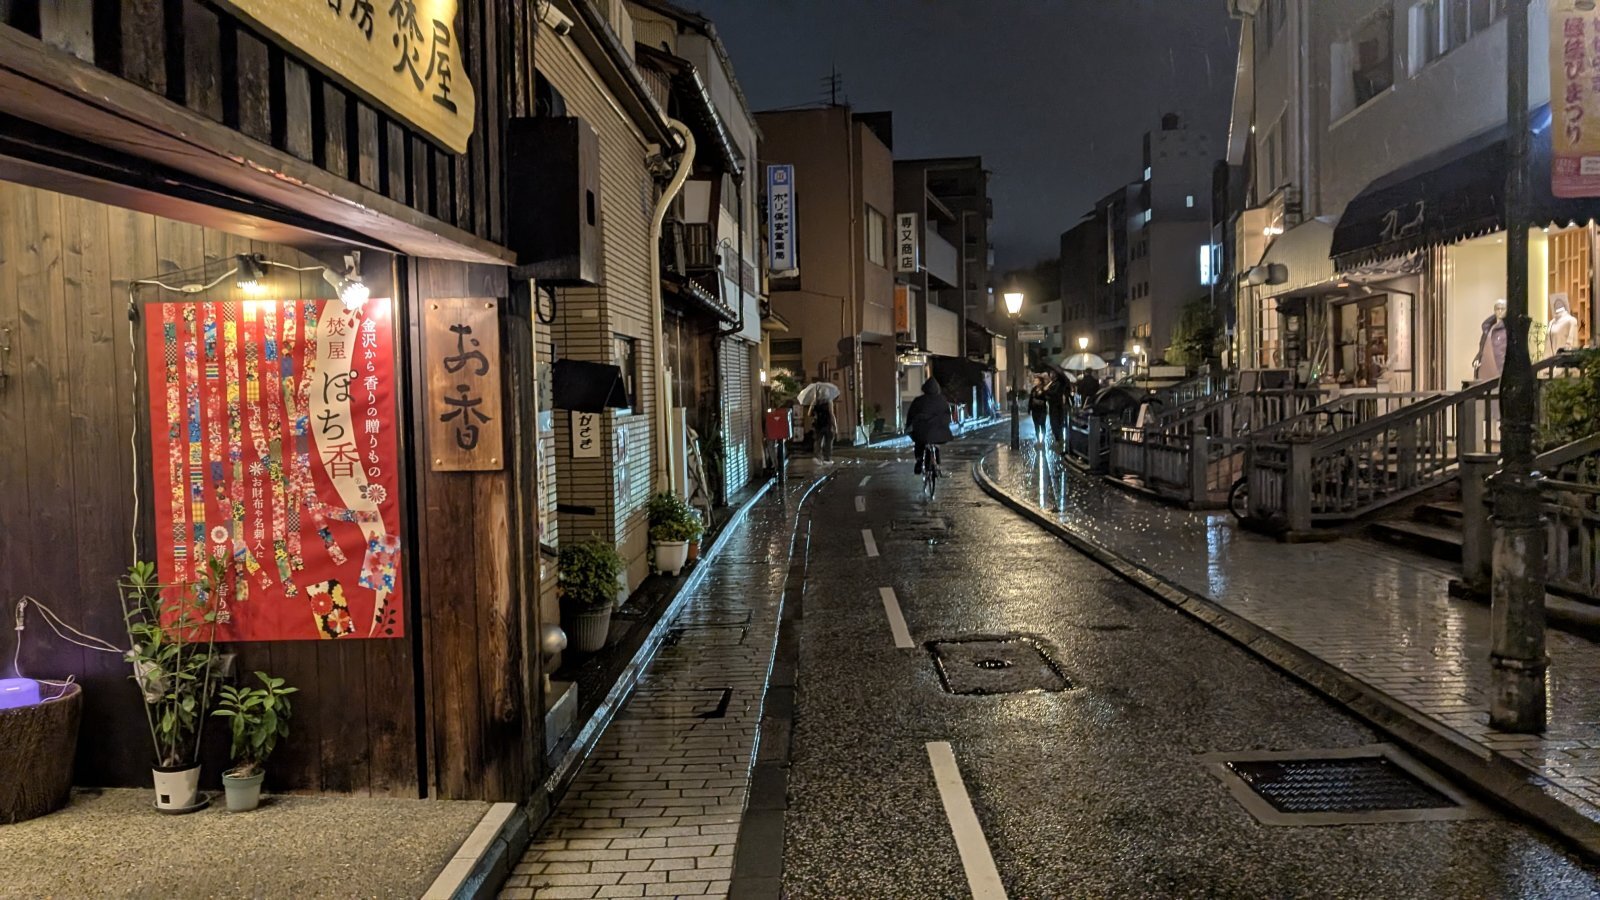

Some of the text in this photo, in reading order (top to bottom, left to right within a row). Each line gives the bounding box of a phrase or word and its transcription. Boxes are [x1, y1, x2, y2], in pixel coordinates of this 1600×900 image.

[316, 317, 360, 480] 焚屋 ぽち香
[361, 318, 381, 478] 金沢から香りの贈りもの
[440, 324, 493, 451] お香
